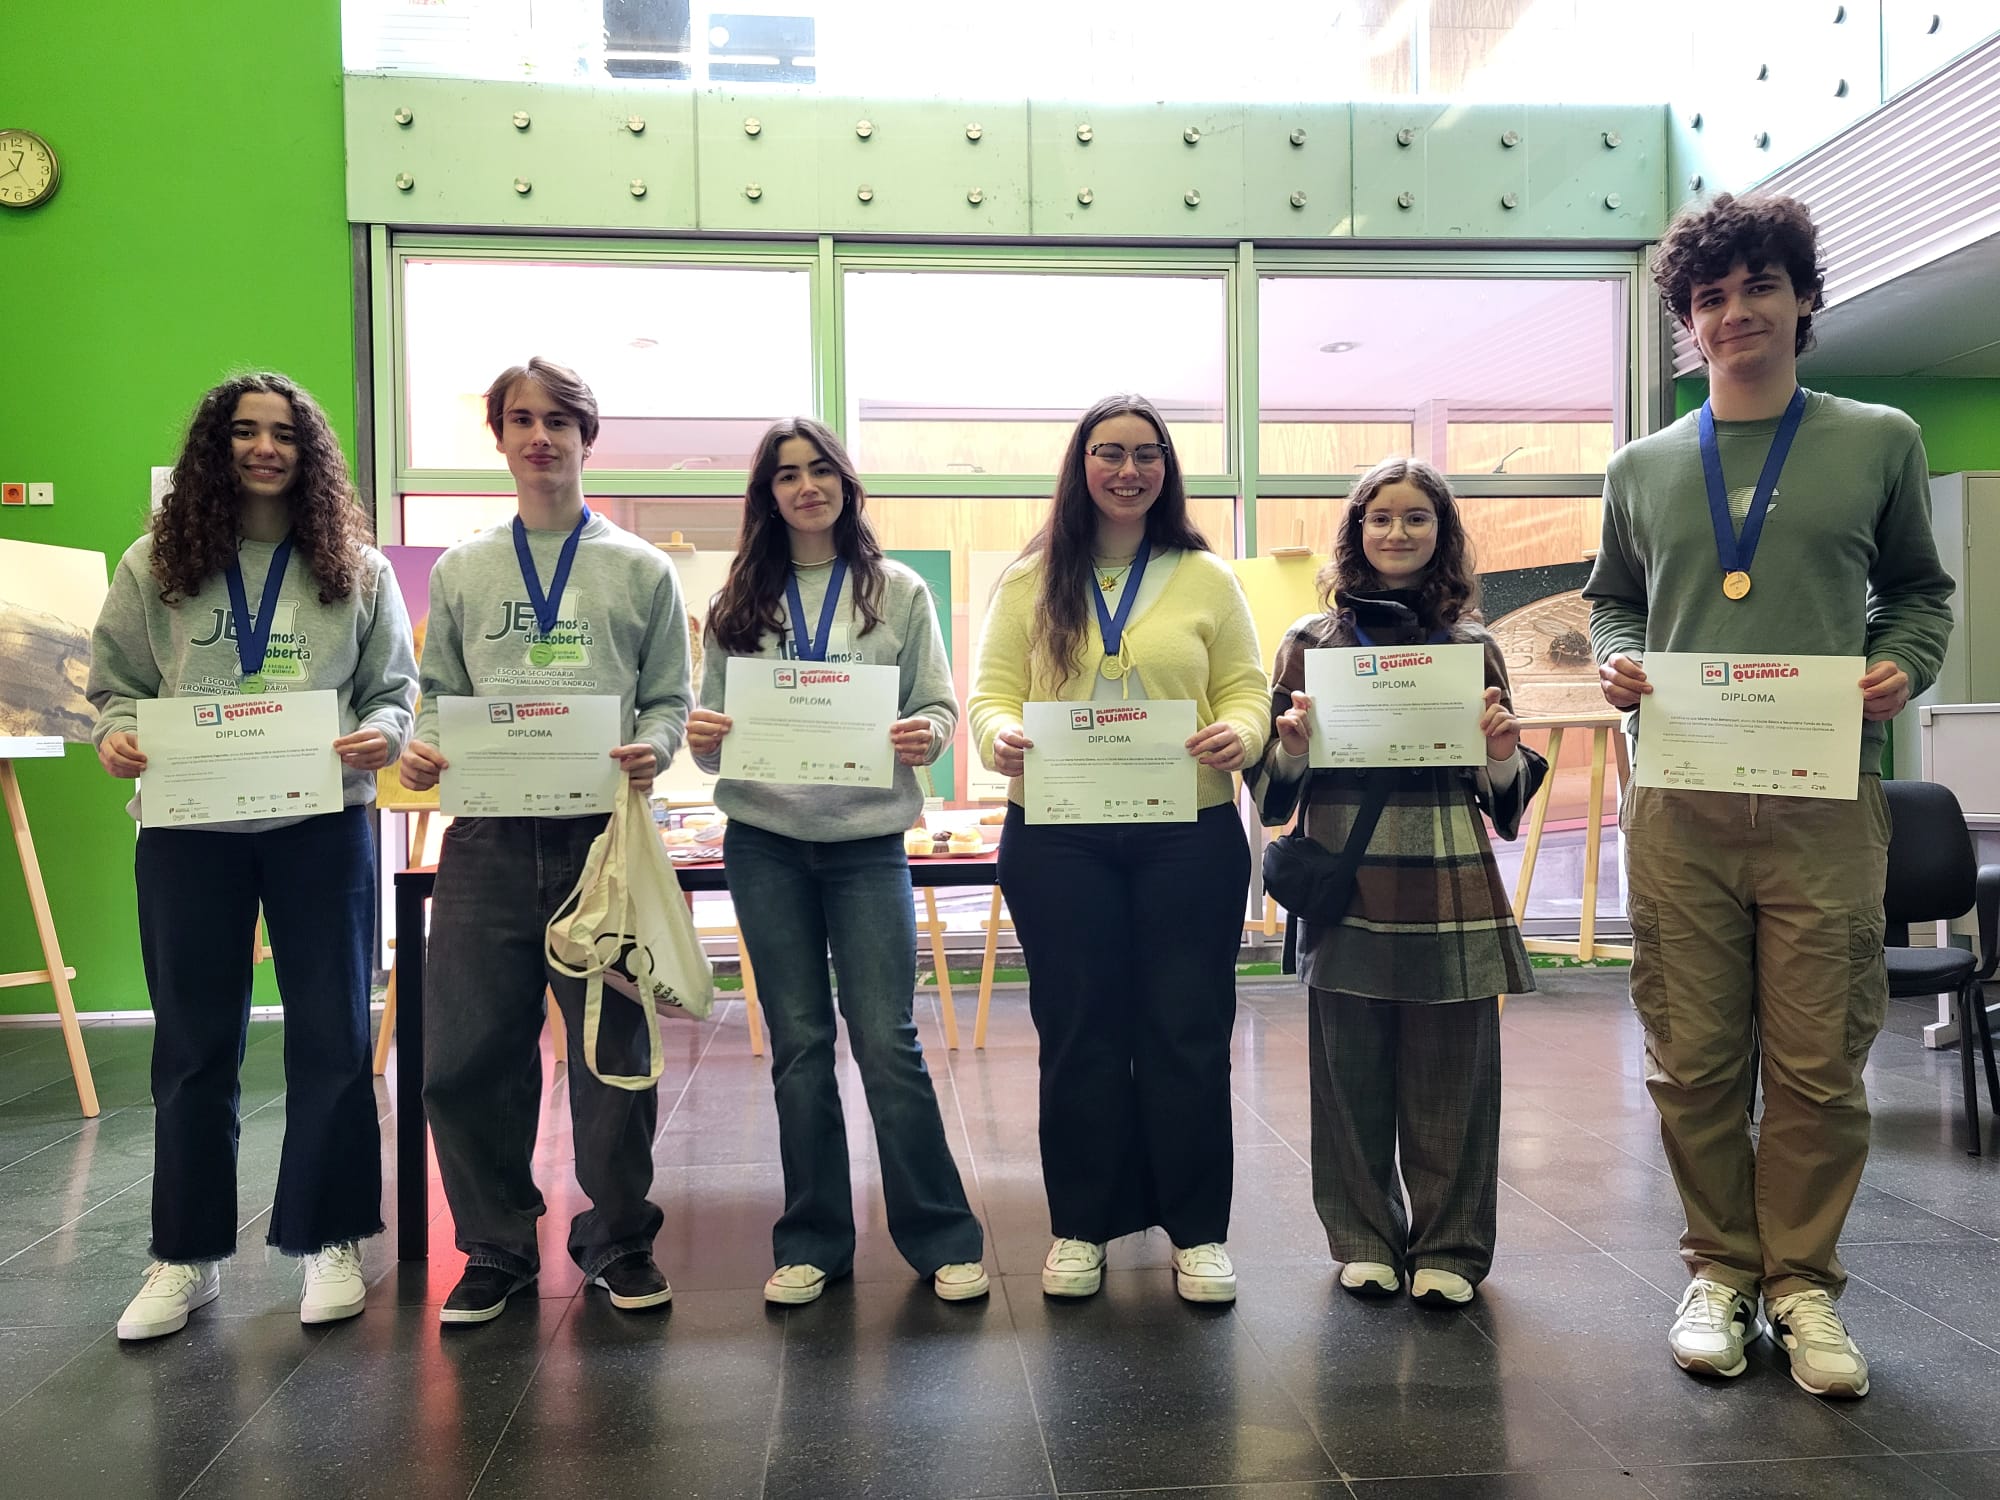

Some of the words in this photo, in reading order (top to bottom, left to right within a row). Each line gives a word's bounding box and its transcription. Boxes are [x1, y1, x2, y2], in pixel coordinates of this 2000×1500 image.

[11, 138, 23, 148] 12
[36, 151, 46, 162] 2
[41, 165, 50, 175] 3
[37, 178, 44, 188] 4
[1, 187, 9, 197] 7
[14, 191, 23, 201] 6
[28, 188, 36, 198] 5
[497, 668, 526, 676] ESCOLA
[202, 676, 235, 688] ESCOLA
[1372, 680, 1417, 689] DIPLOMA
[789, 696, 832, 706] DIPLOMA
[1721, 692, 1776, 703] DIPLOMA
[215, 728, 266, 739] DIPLOMA
[507, 729, 553, 738] DIPLOMA
[1088, 735, 1132, 743] DIPLOMA
